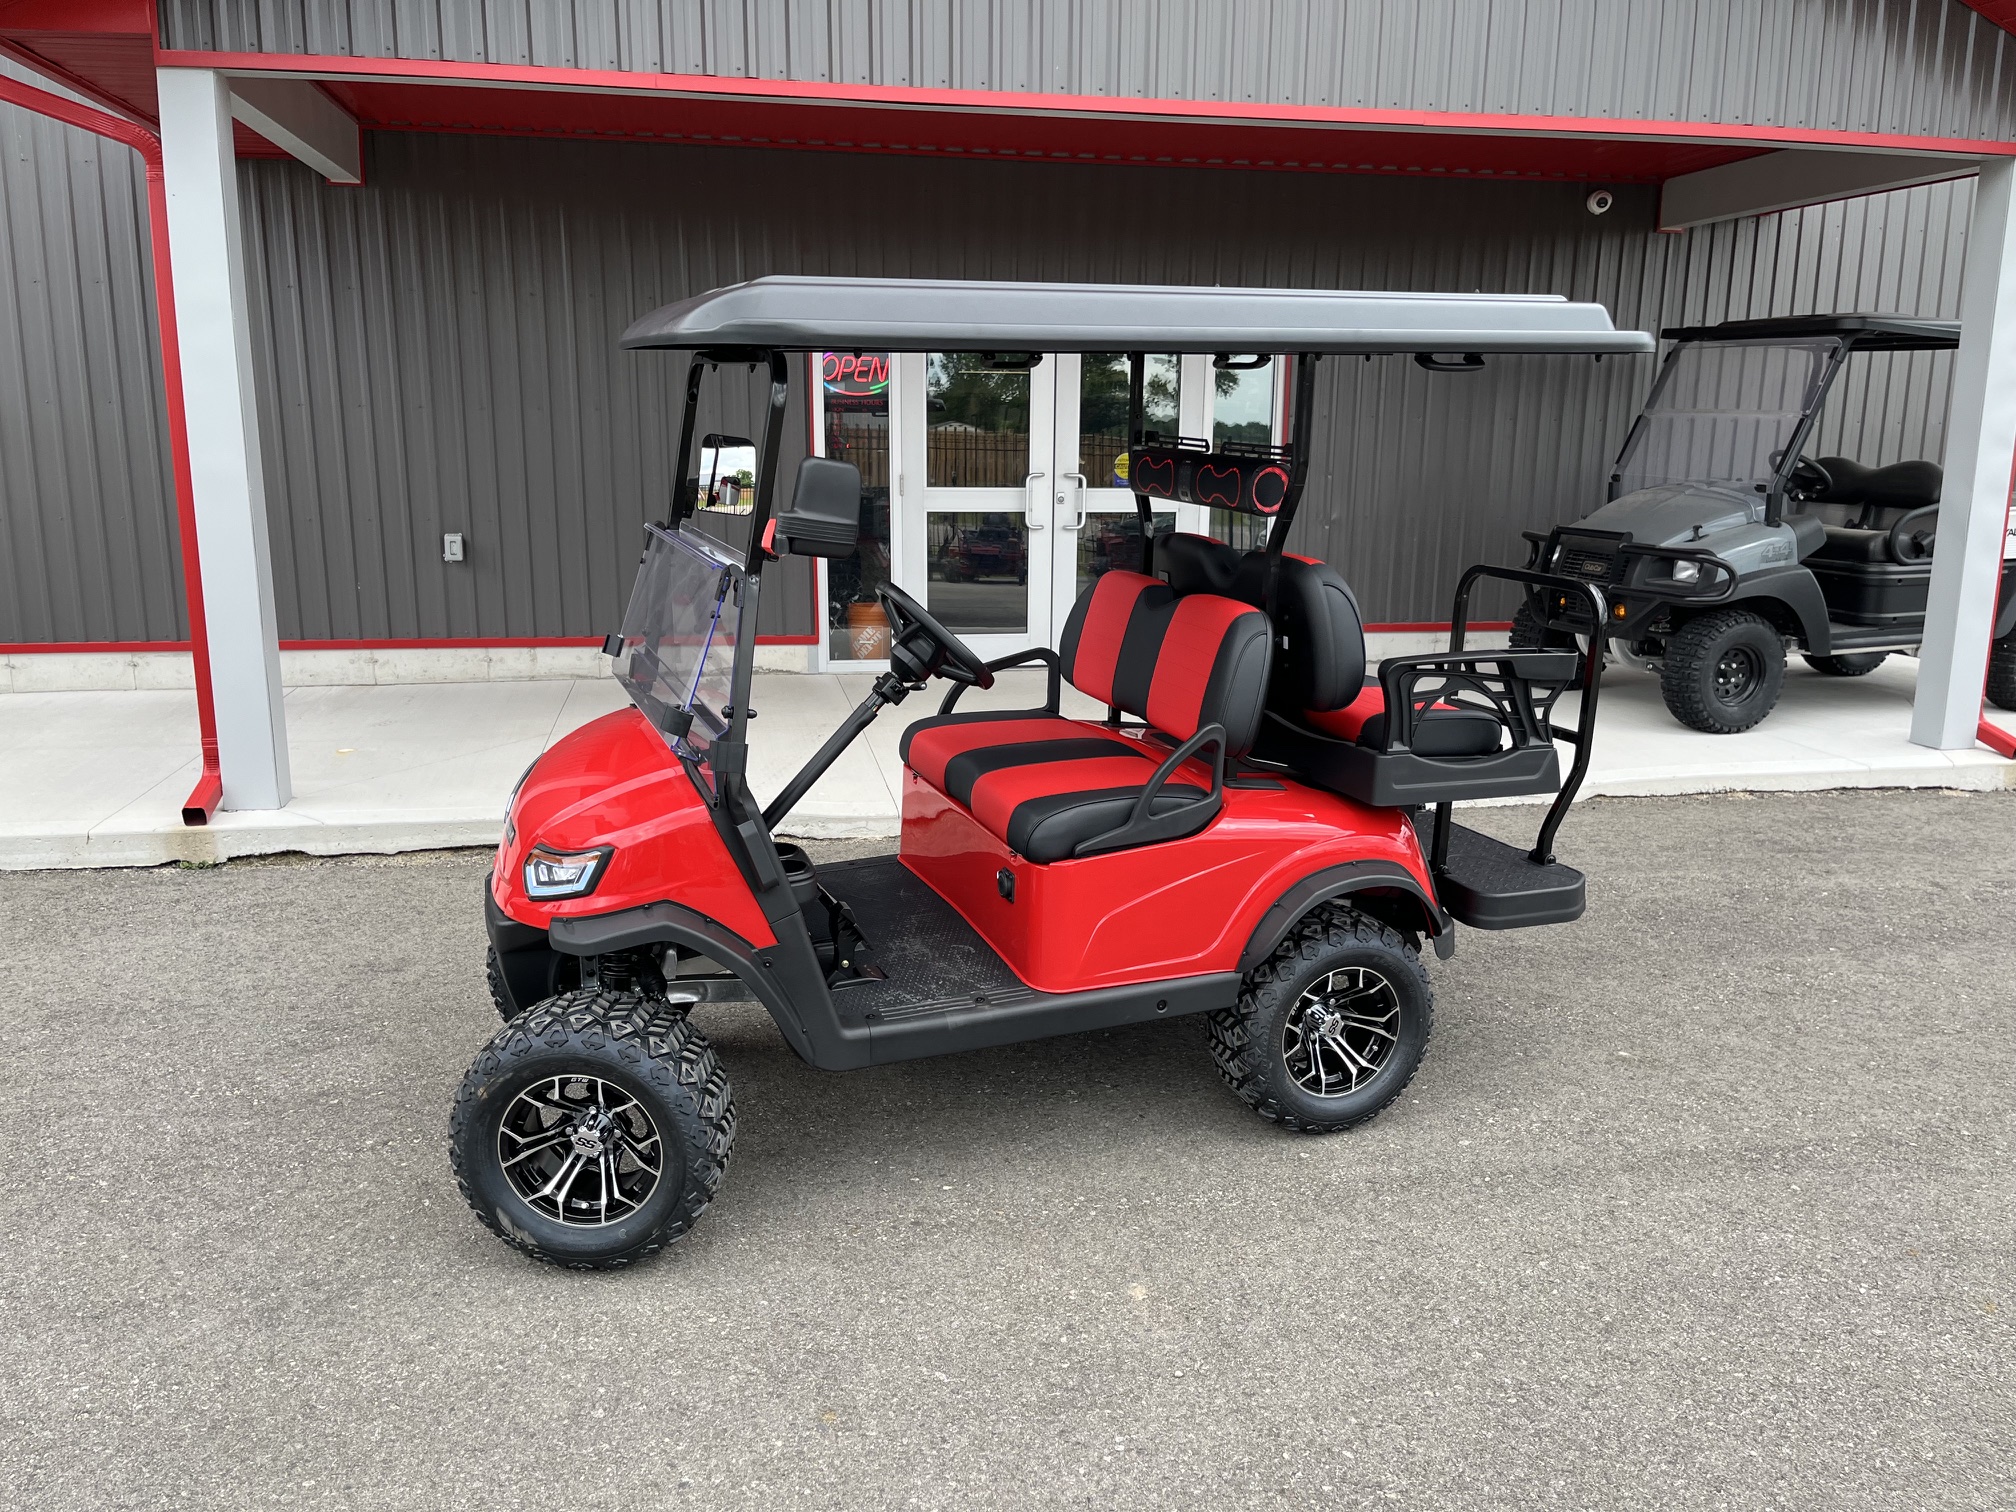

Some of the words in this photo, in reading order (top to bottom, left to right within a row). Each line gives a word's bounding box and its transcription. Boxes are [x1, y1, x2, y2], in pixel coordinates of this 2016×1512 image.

[823, 355, 889, 383] OPEN
[831, 398, 859, 406] BUSINESS
[852, 626, 876, 652] HOME
[857, 630, 882, 660] DEPOT
[1328, 1018, 1340, 1035] SS
[575, 1136, 598, 1149] SS
